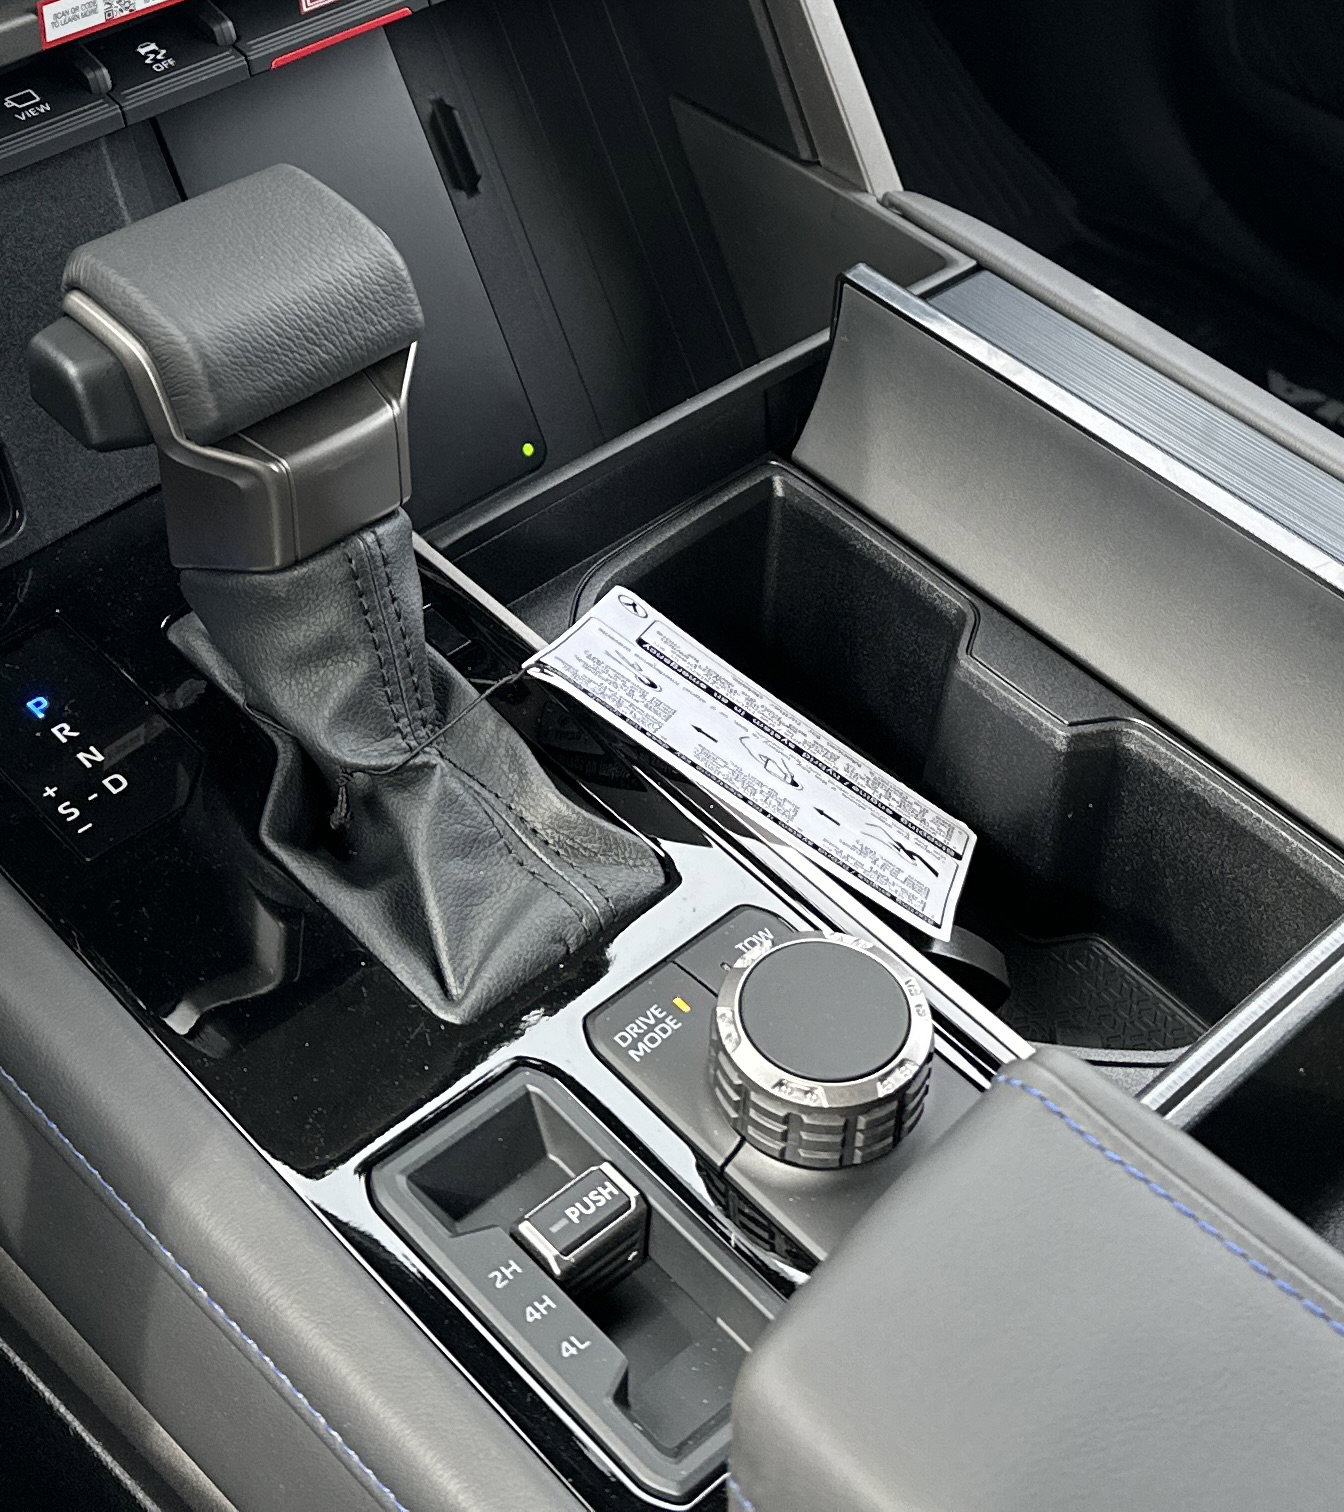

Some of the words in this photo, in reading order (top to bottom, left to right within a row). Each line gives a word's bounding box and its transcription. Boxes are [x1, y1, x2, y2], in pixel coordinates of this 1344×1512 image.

[152, 57, 177, 72] OFF
[14, 102, 52, 122] VIEW
[26, 696, 49, 719] P
[50, 722, 80, 743] R
[76, 745, 105, 769] N
[101, 773, 128, 795] D
[57, 801, 80, 822] S
[613, 1003, 667, 1048] DRIVE
[628, 1014, 682, 1062] MODE
[564, 1181, 619, 1224] PUSH
[488, 1259, 523, 1288] 2H
[525, 1294, 557, 1323] 4H
[561, 1336, 592, 1358] 4L
